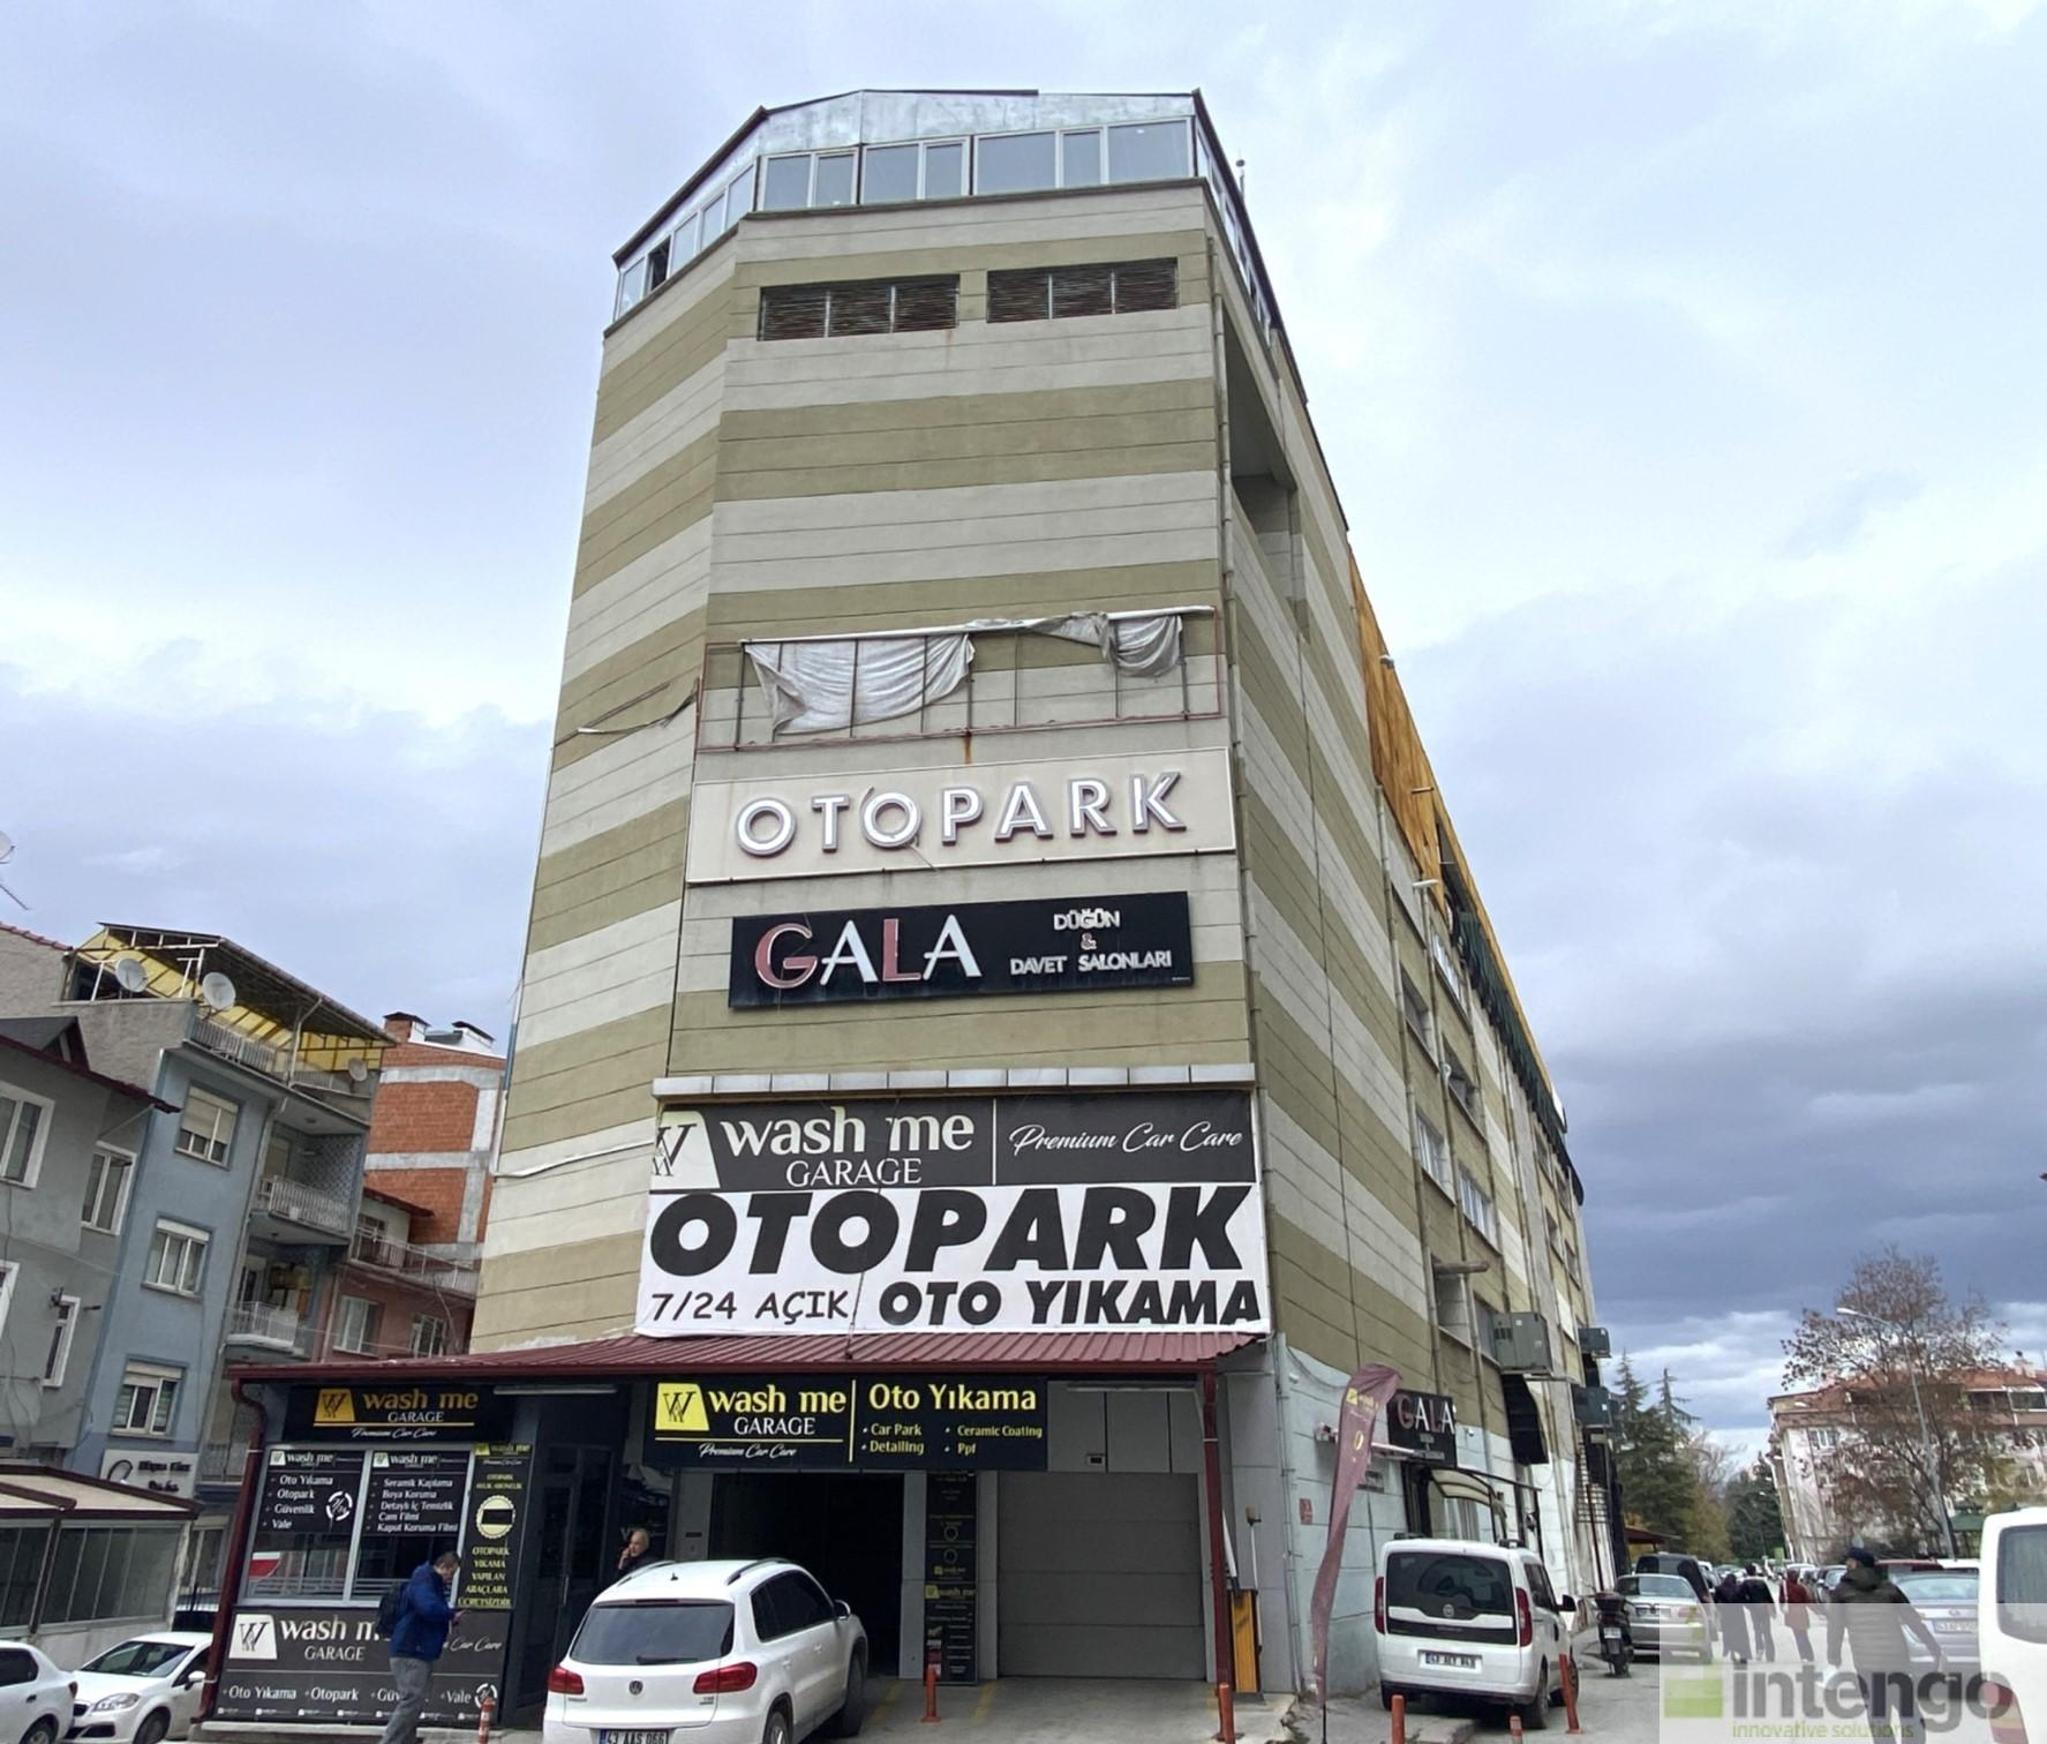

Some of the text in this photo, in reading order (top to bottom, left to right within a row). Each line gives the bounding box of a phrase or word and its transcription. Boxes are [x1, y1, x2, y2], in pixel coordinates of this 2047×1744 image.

[735, 771, 1187, 856] OTOPARK
[1053, 907, 1120, 931] DÜĞÜN
[1080, 932, 1097, 950] &
[753, 914, 982, 990] GALA
[1078, 950, 1173, 972] SALONLARI
[1010, 955, 1068, 975] DAVET
[720, 1106, 975, 1157] wash me
[1009, 1120, 1243, 1156] Premium Car Care
[786, 1158, 922, 1188] GARAGE
[651, 1185, 1253, 1276] OTOPARK
[651, 1290, 849, 1325] 7/24 AÇIK
[879, 1280, 1261, 1326] OTO YIKAMA
[362, 1388, 479, 1410] wash me
[708, 1384, 847, 1413] wash me
[869, 1383, 1037, 1411] Oto Yıkama
[387, 1410, 446, 1423] GARAGE
[1397, 1392, 1456, 1435] GALA
[734, 1416, 816, 1435] GARAGE
[870, 1422, 922, 1436] Car Park
[957, 1425, 1043, 1439] Ceramic Coating
[699, 1443, 798, 1458] Premium Car Care
[870, 1440, 924, 1455] Detailing
[957, 1443, 977, 1456] Ppf
[280, 1474, 298, 1485] Oto
[277, 1488, 315, 1501] Otopark
[404, 1489, 437, 1499] Koruma
[272, 1518, 292, 1529] Vale
[378, 1512, 398, 1521] Cam
[404, 1523, 437, 1532] Koruma
[279, 1614, 347, 1641] wash
[304, 1646, 366, 1661] GARAGE
[228, 1685, 297, 1700] Oto Yıkama
[310, 1686, 359, 1703] Otopark
[446, 1689, 472, 1704] Vale
